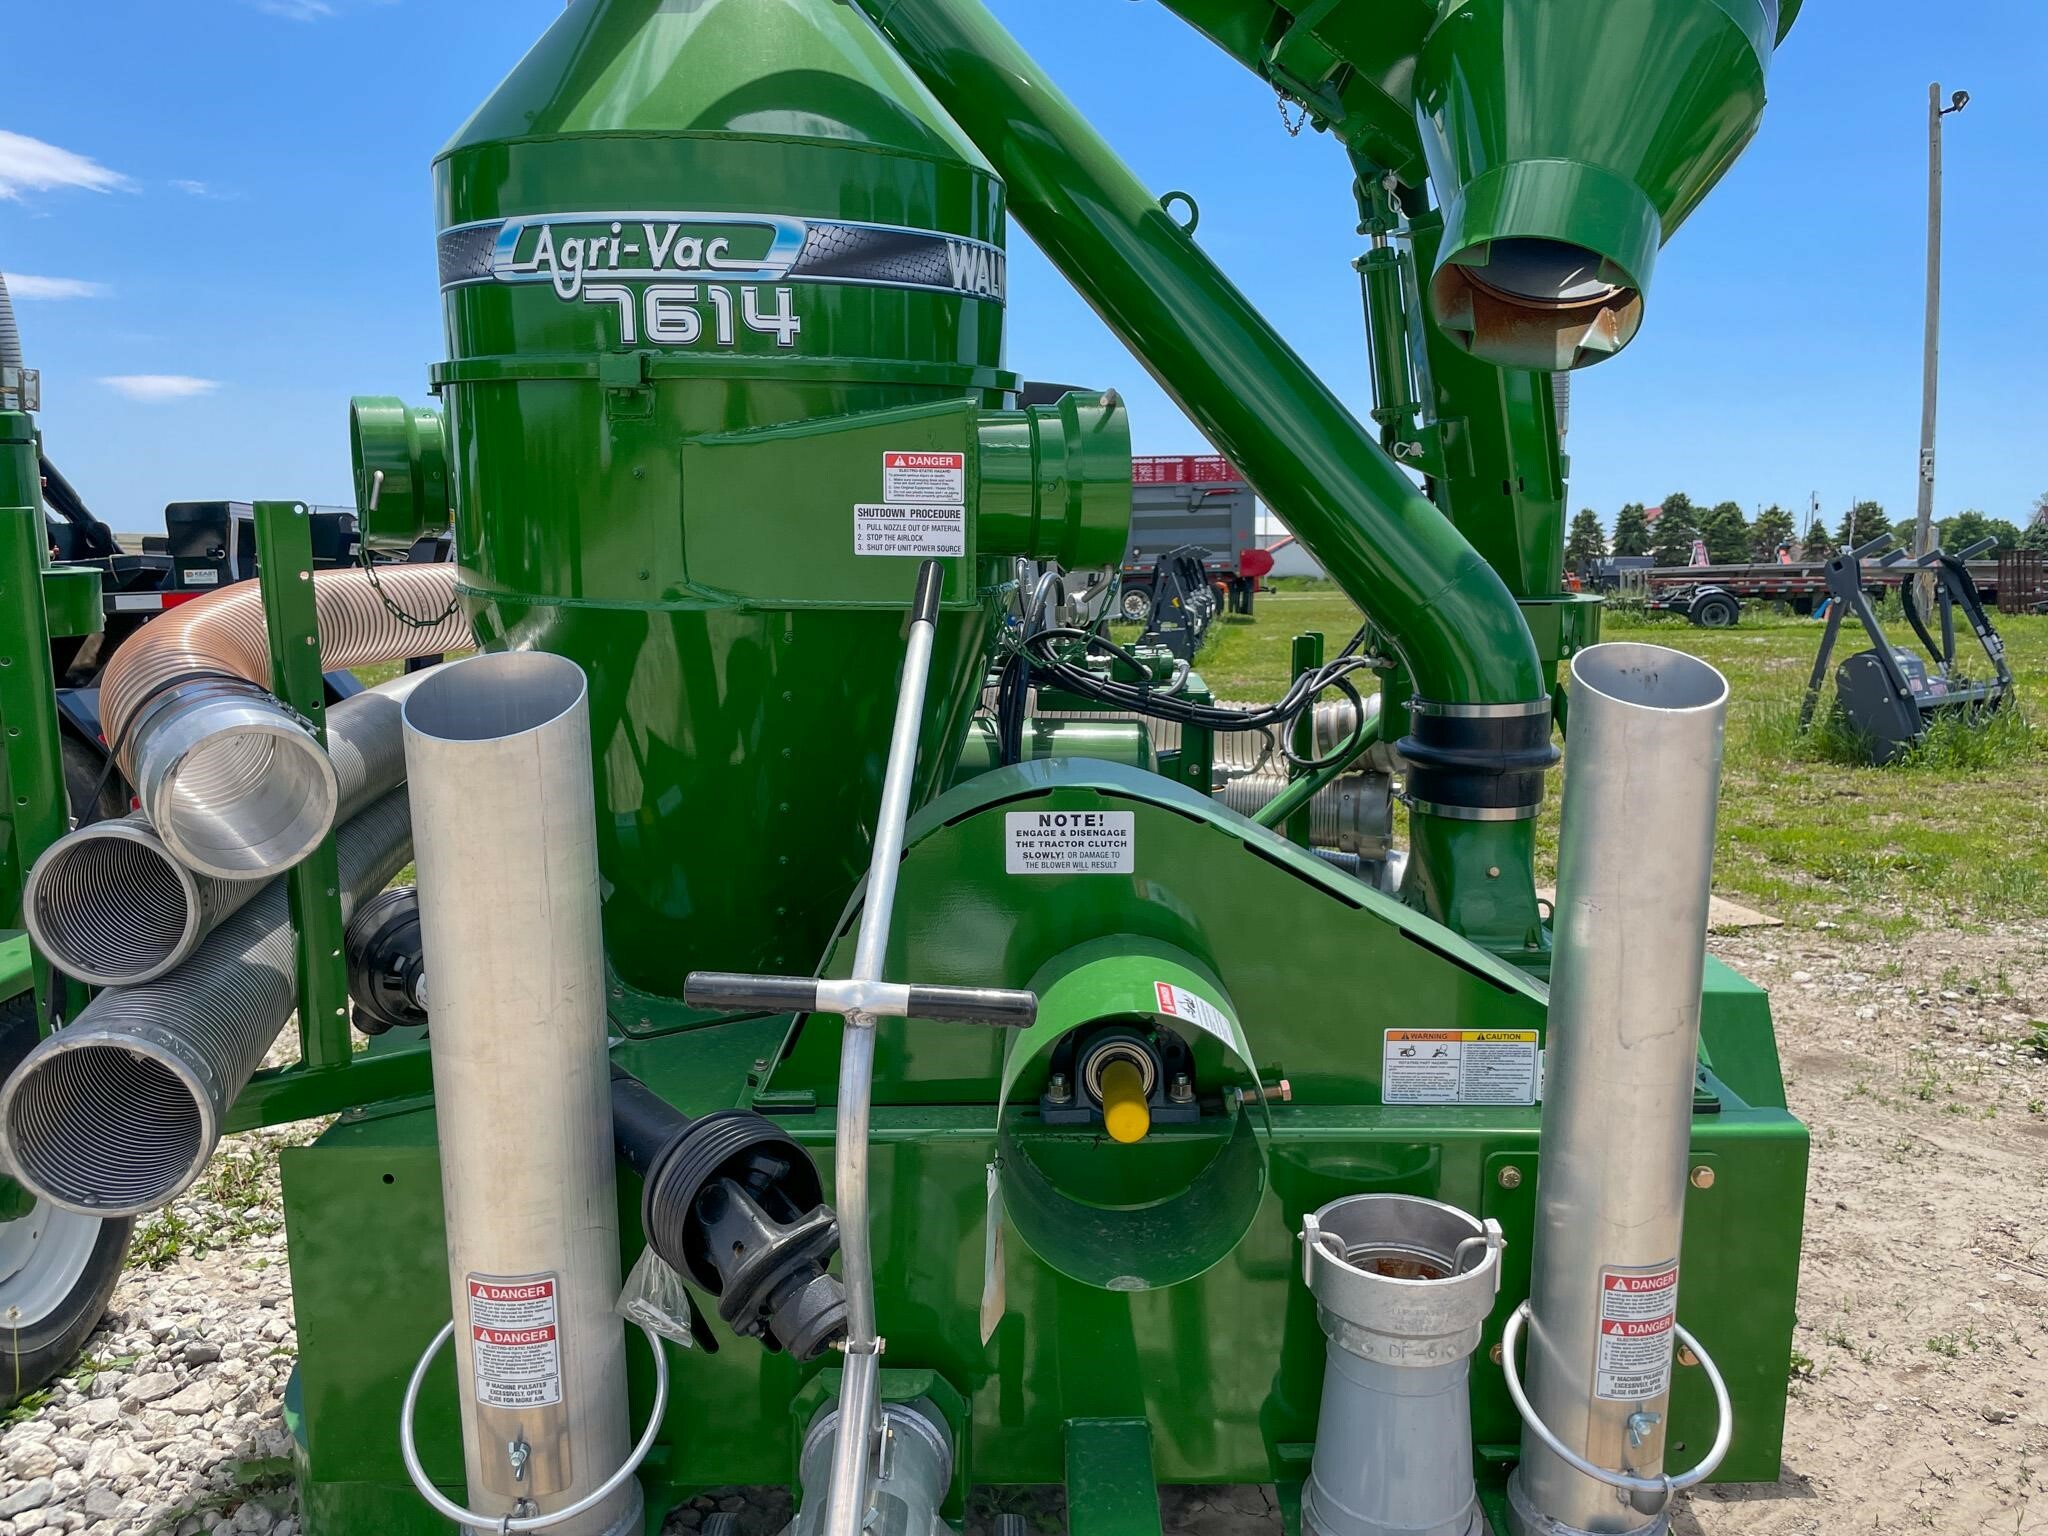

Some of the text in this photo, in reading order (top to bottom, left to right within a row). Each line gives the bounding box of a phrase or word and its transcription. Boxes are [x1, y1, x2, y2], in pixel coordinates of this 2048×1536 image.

[530, 221, 732, 299] Agri-Vac
[582, 284, 800, 346] 7614
[908, 456, 954, 466] DANGER
[858, 507, 961, 519] SHUTDOWN PROCEDURE
[866, 523, 882, 531] PULL
[884, 524, 906, 532] NOZZLE
[908, 524, 920, 532] OUT
[931, 525, 961, 533] MATERIAL
[866, 533, 883, 541] STOP
[897, 534, 923, 542] AIRLOCK
[1039, 814, 1104, 827] NOTE!
[1016, 829, 1127, 837] ENGAGE & DISENGAGE
[1016, 840, 1127, 848] THE TRACTOR CLUTCH
[1022, 851, 1120, 859] SLOWLY! OR DAMAGE TO
[1025, 861, 1117, 869] THE BLOWER WILL RESULT
[1631, 1273, 1674, 1290] DANGER
[491, 1286, 546, 1299] DANGER
[1628, 1317, 1671, 1334] DANGER
[494, 1330, 548, 1343] DANGER
[491, 1382, 516, 1390] MACHINE
[517, 1381, 547, 1390] PULSATES
